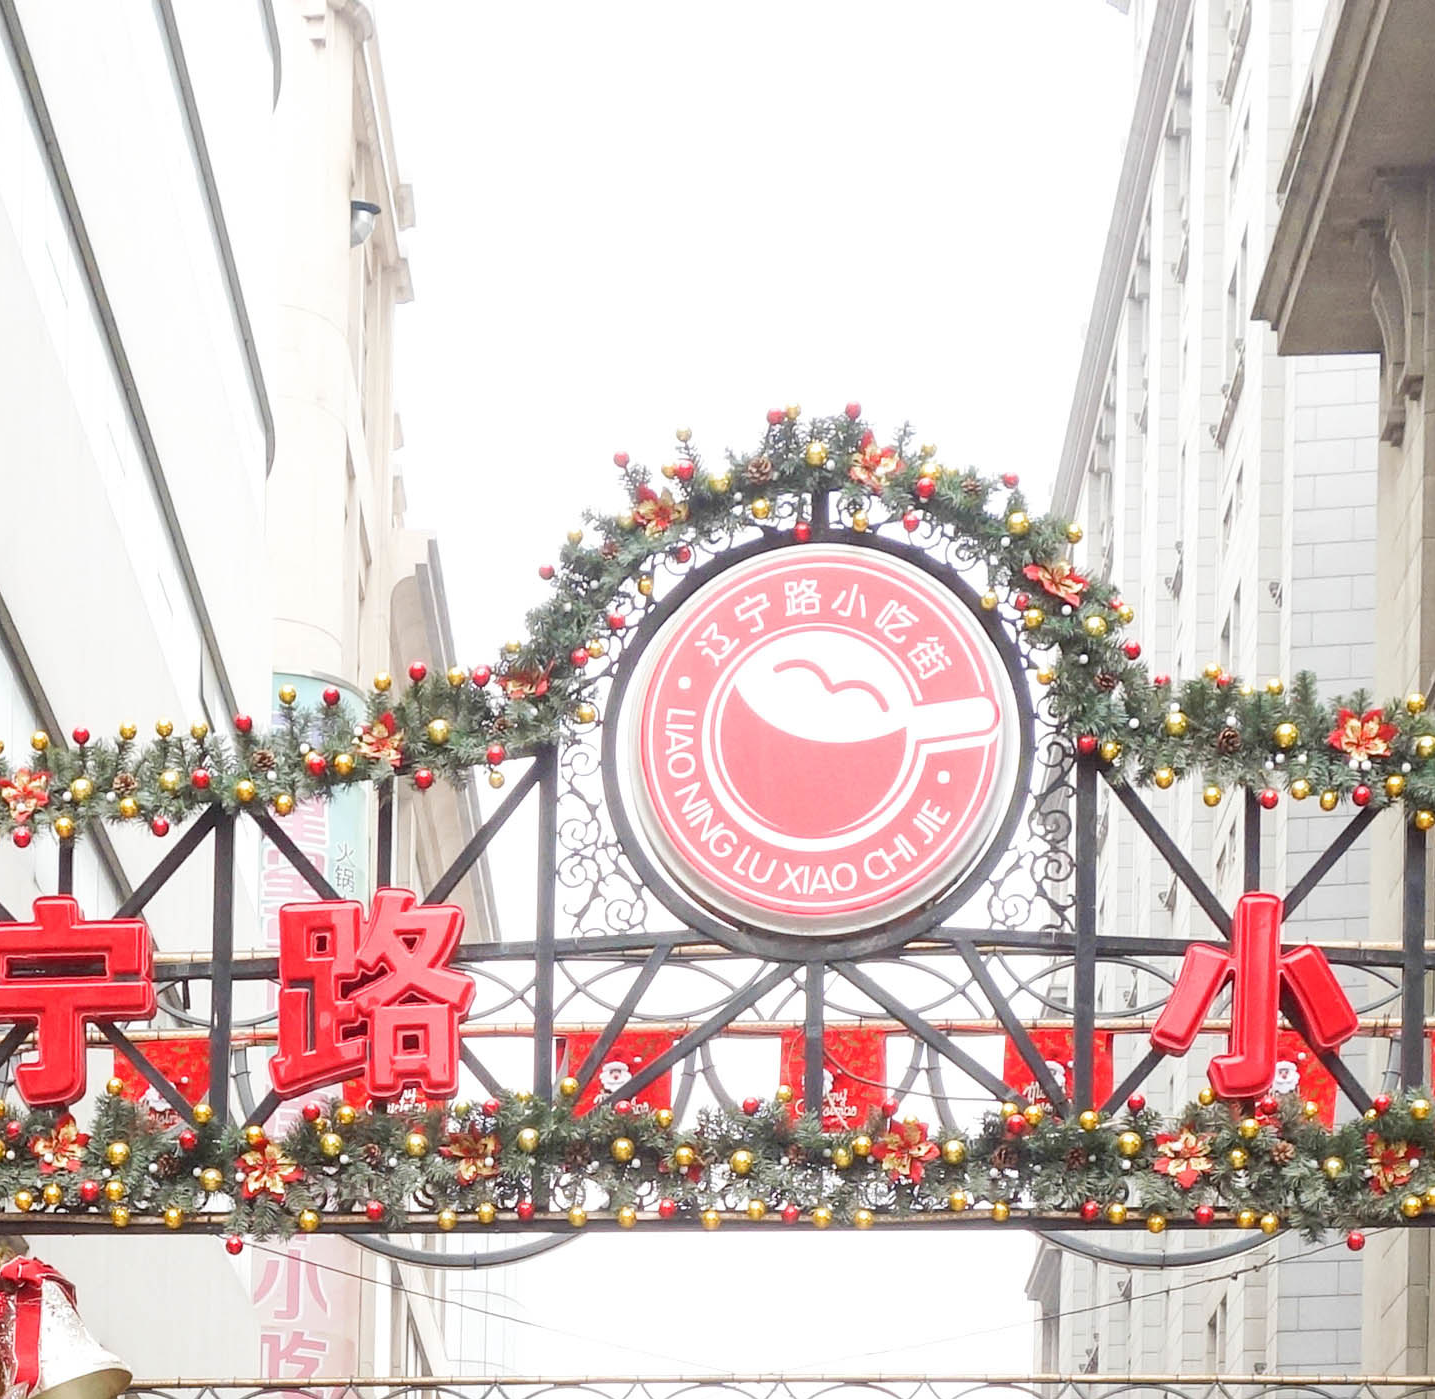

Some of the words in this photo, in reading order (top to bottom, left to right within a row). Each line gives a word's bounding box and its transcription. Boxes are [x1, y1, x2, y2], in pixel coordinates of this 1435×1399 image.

[694, 578, 953, 681] 辽宁路小吃街
[664, 707, 696, 779] LIAO
[675, 783, 734, 859] NING
[912, 798, 951, 847] JIE
[732, 845, 777, 884] LU
[778, 861, 858, 895] XIAO
[863, 832, 918, 882] CHI
